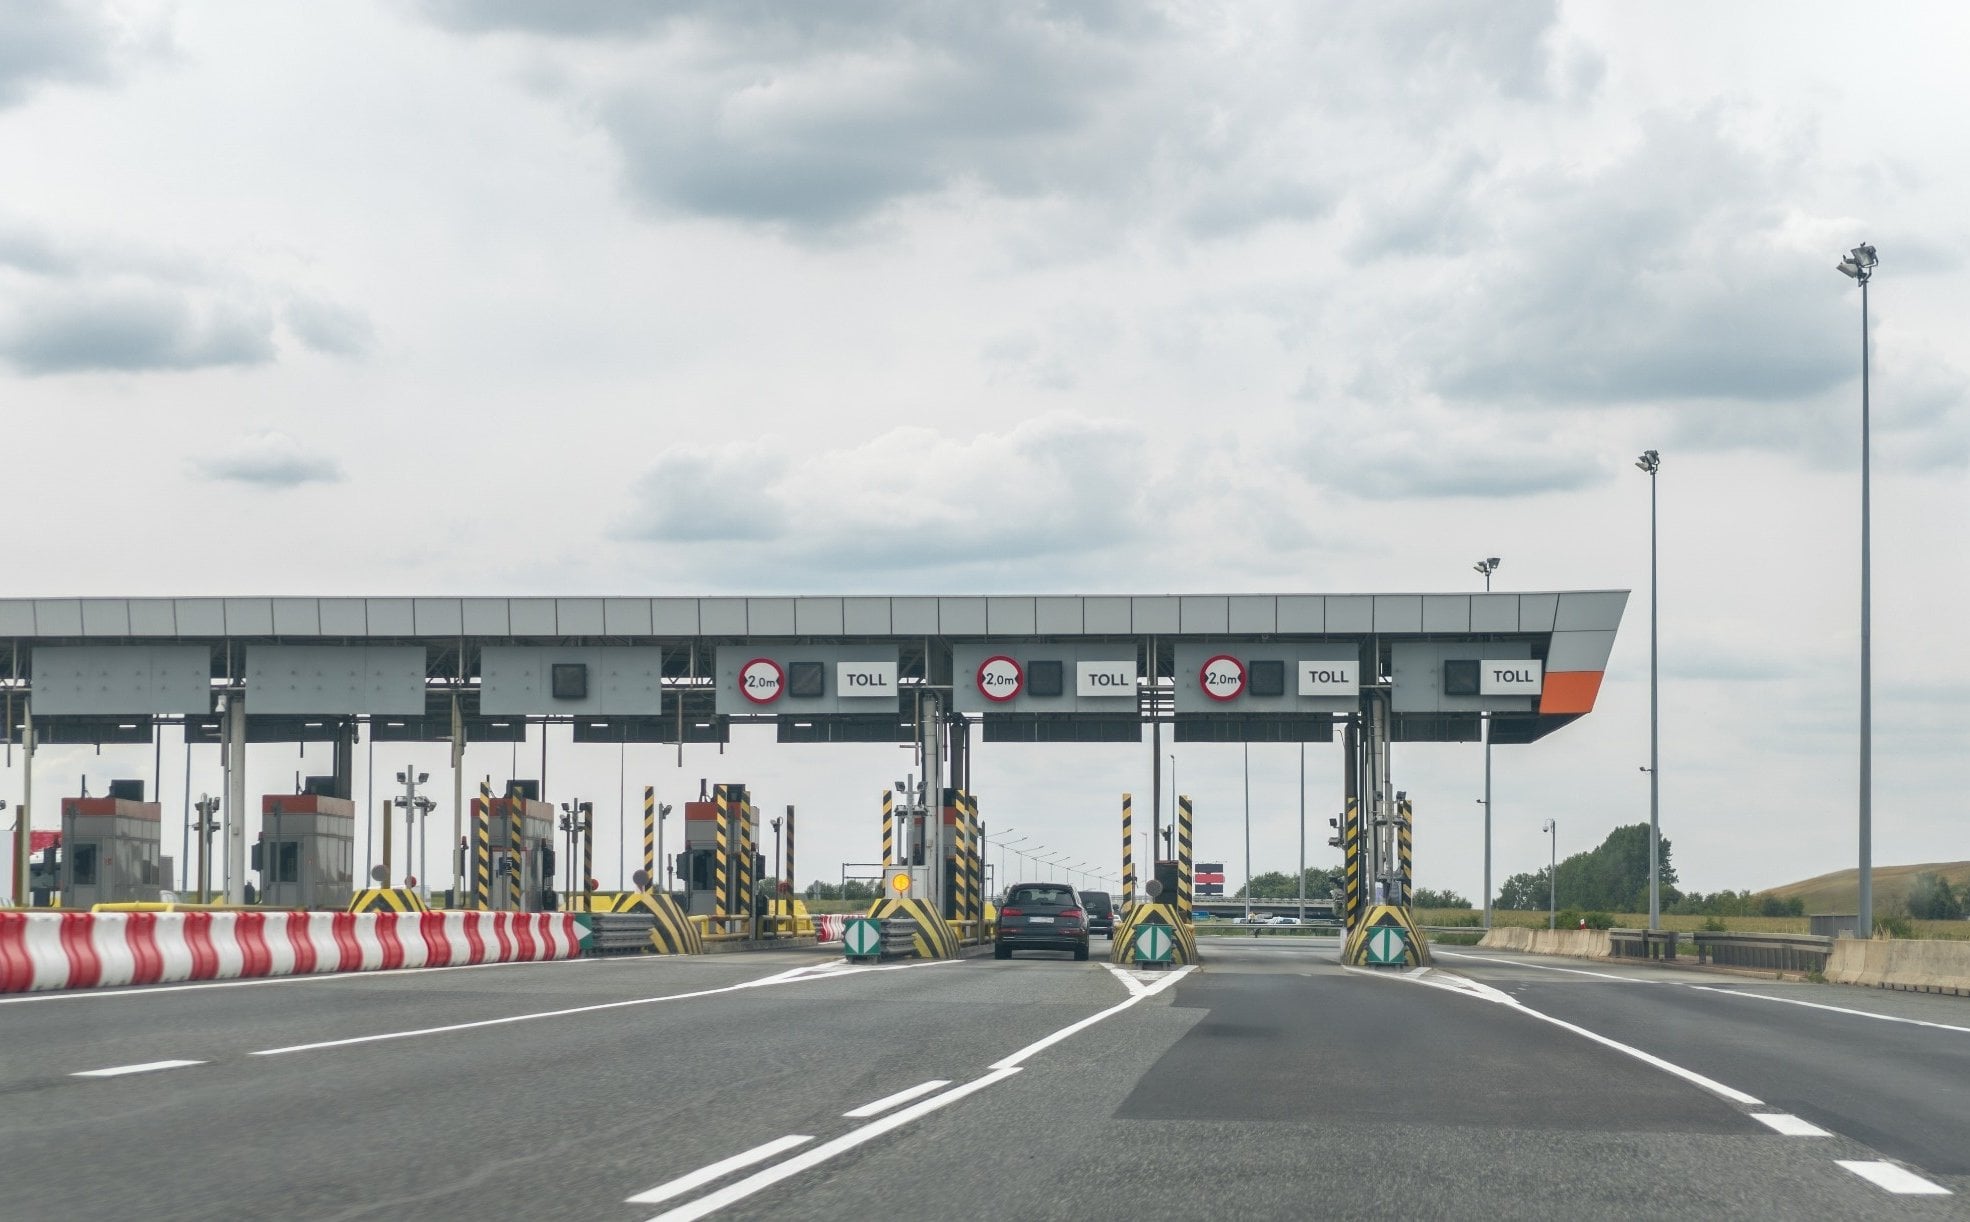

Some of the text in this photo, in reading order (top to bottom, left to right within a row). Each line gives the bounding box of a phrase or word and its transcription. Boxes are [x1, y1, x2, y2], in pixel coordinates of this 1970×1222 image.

[846, 673, 887, 686] TOLL
[1088, 673, 1129, 686] TOLL
[1308, 670, 1349, 683] TOLL
[1493, 670, 1534, 683] TOLL
